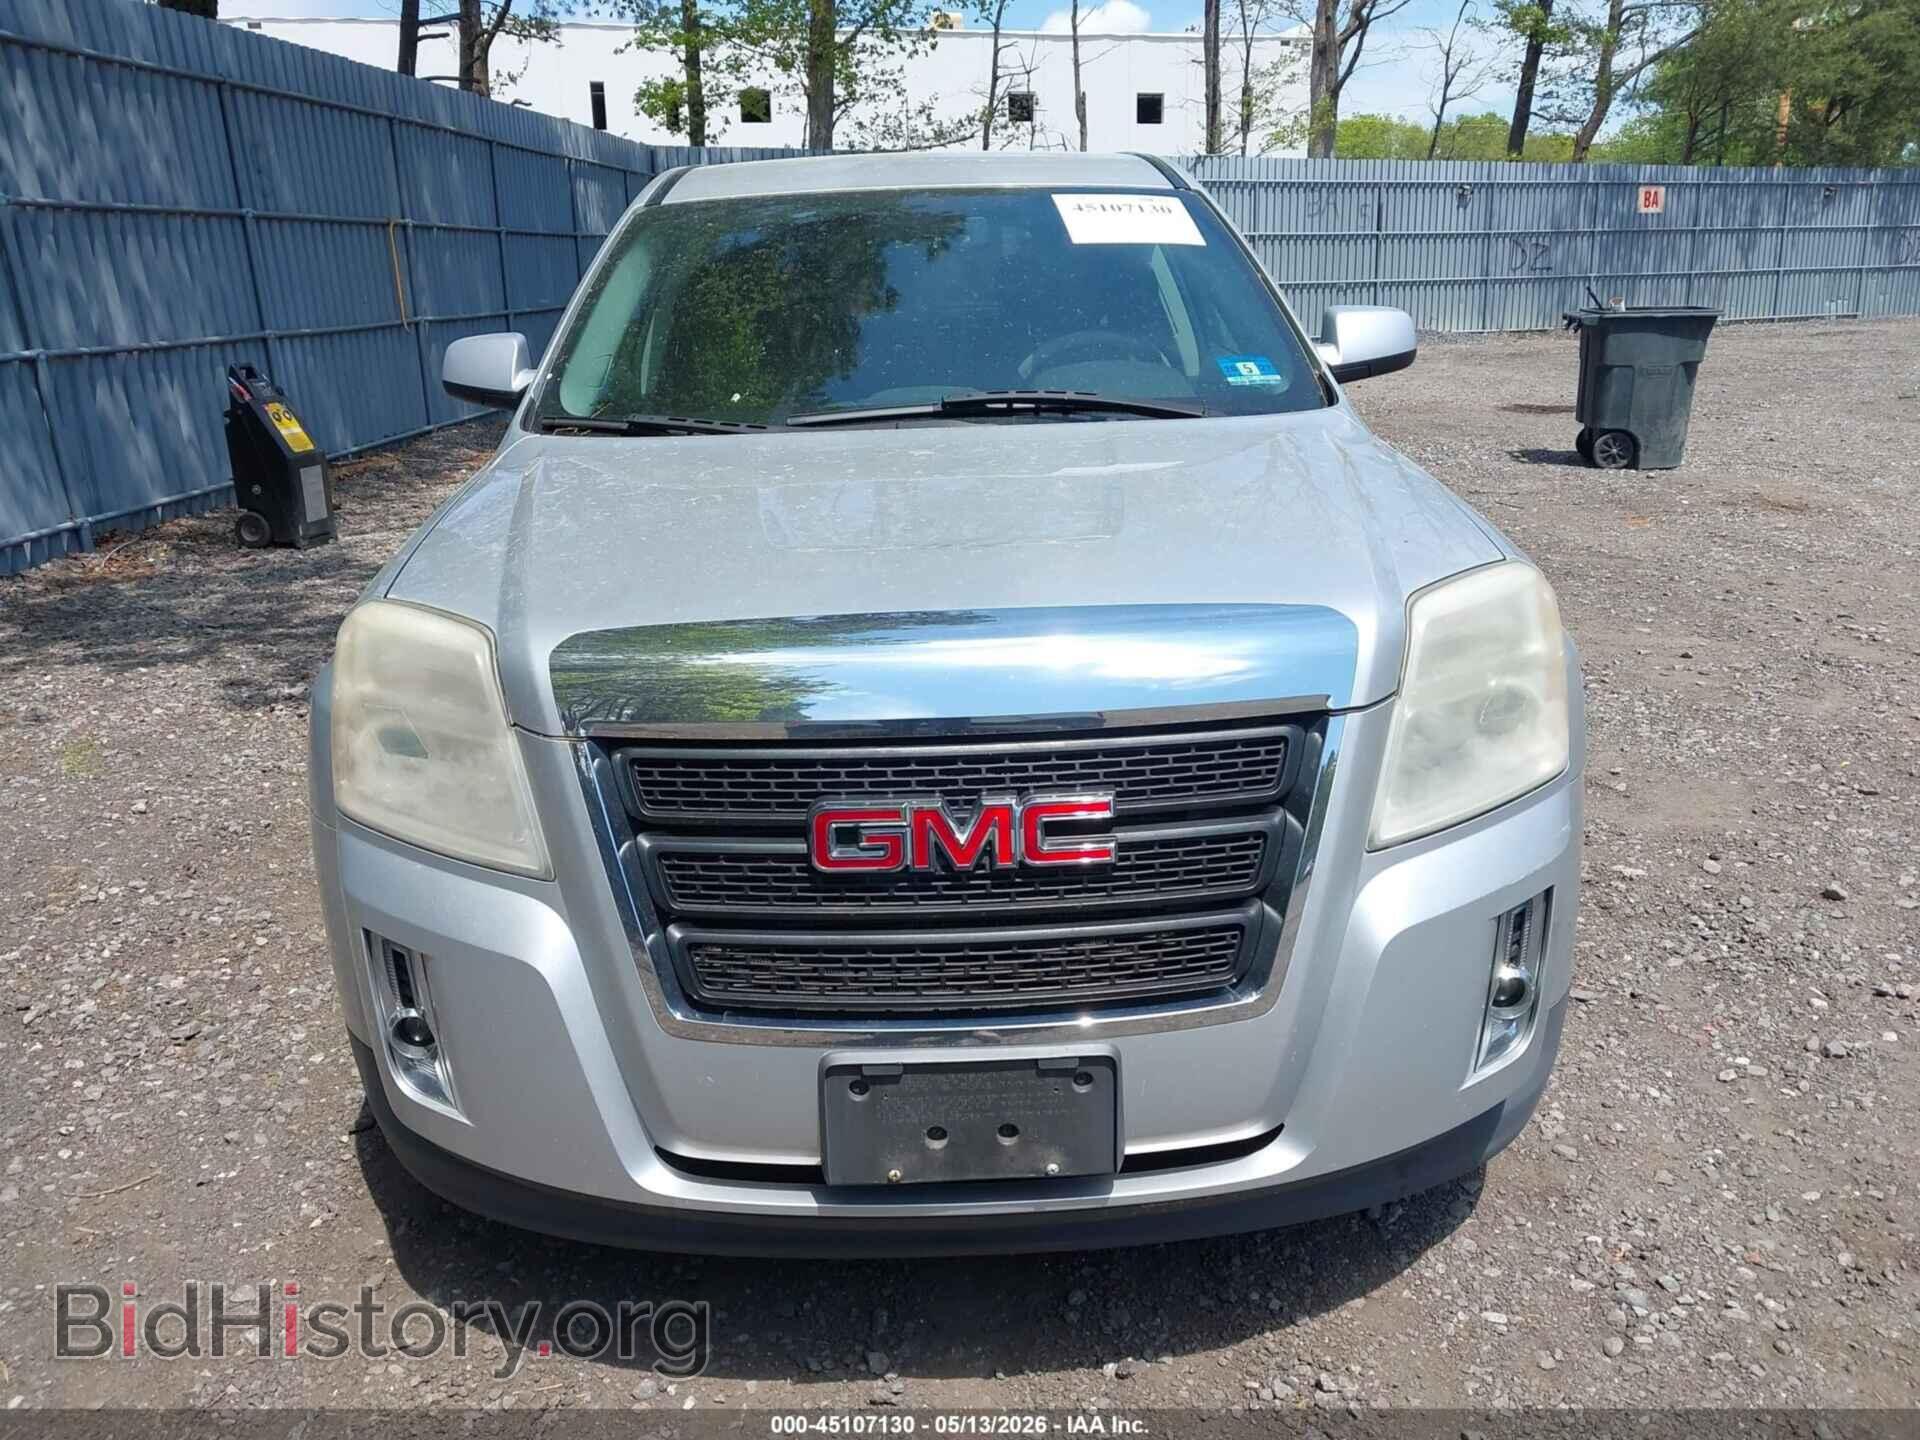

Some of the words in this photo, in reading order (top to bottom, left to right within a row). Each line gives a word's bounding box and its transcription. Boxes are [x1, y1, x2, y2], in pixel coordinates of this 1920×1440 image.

[1643, 190, 1659, 209] BA
[1242, 363, 1254, 374] 5
[807, 791, 1117, 873] GMC
